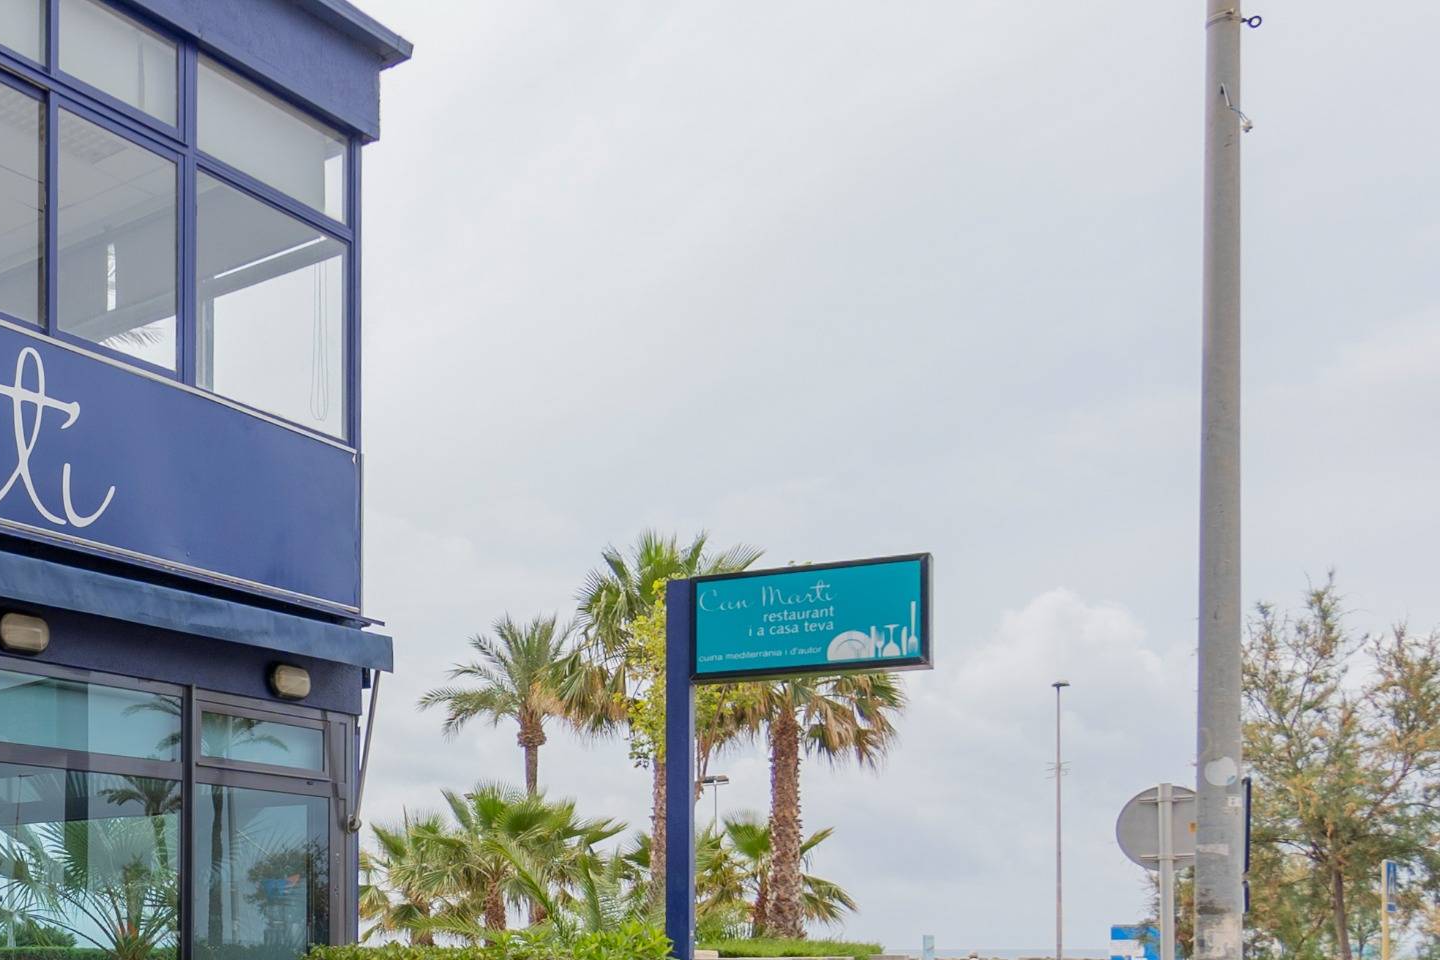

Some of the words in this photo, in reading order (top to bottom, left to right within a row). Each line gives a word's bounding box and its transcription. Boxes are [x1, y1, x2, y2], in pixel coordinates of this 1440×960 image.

[699, 589, 751, 612] Can
[762, 579, 835, 607] Marti
[763, 605, 835, 622] restaurant
[756, 626, 765, 637] a
[769, 623, 799, 635] casa
[804, 620, 834, 632] teva
